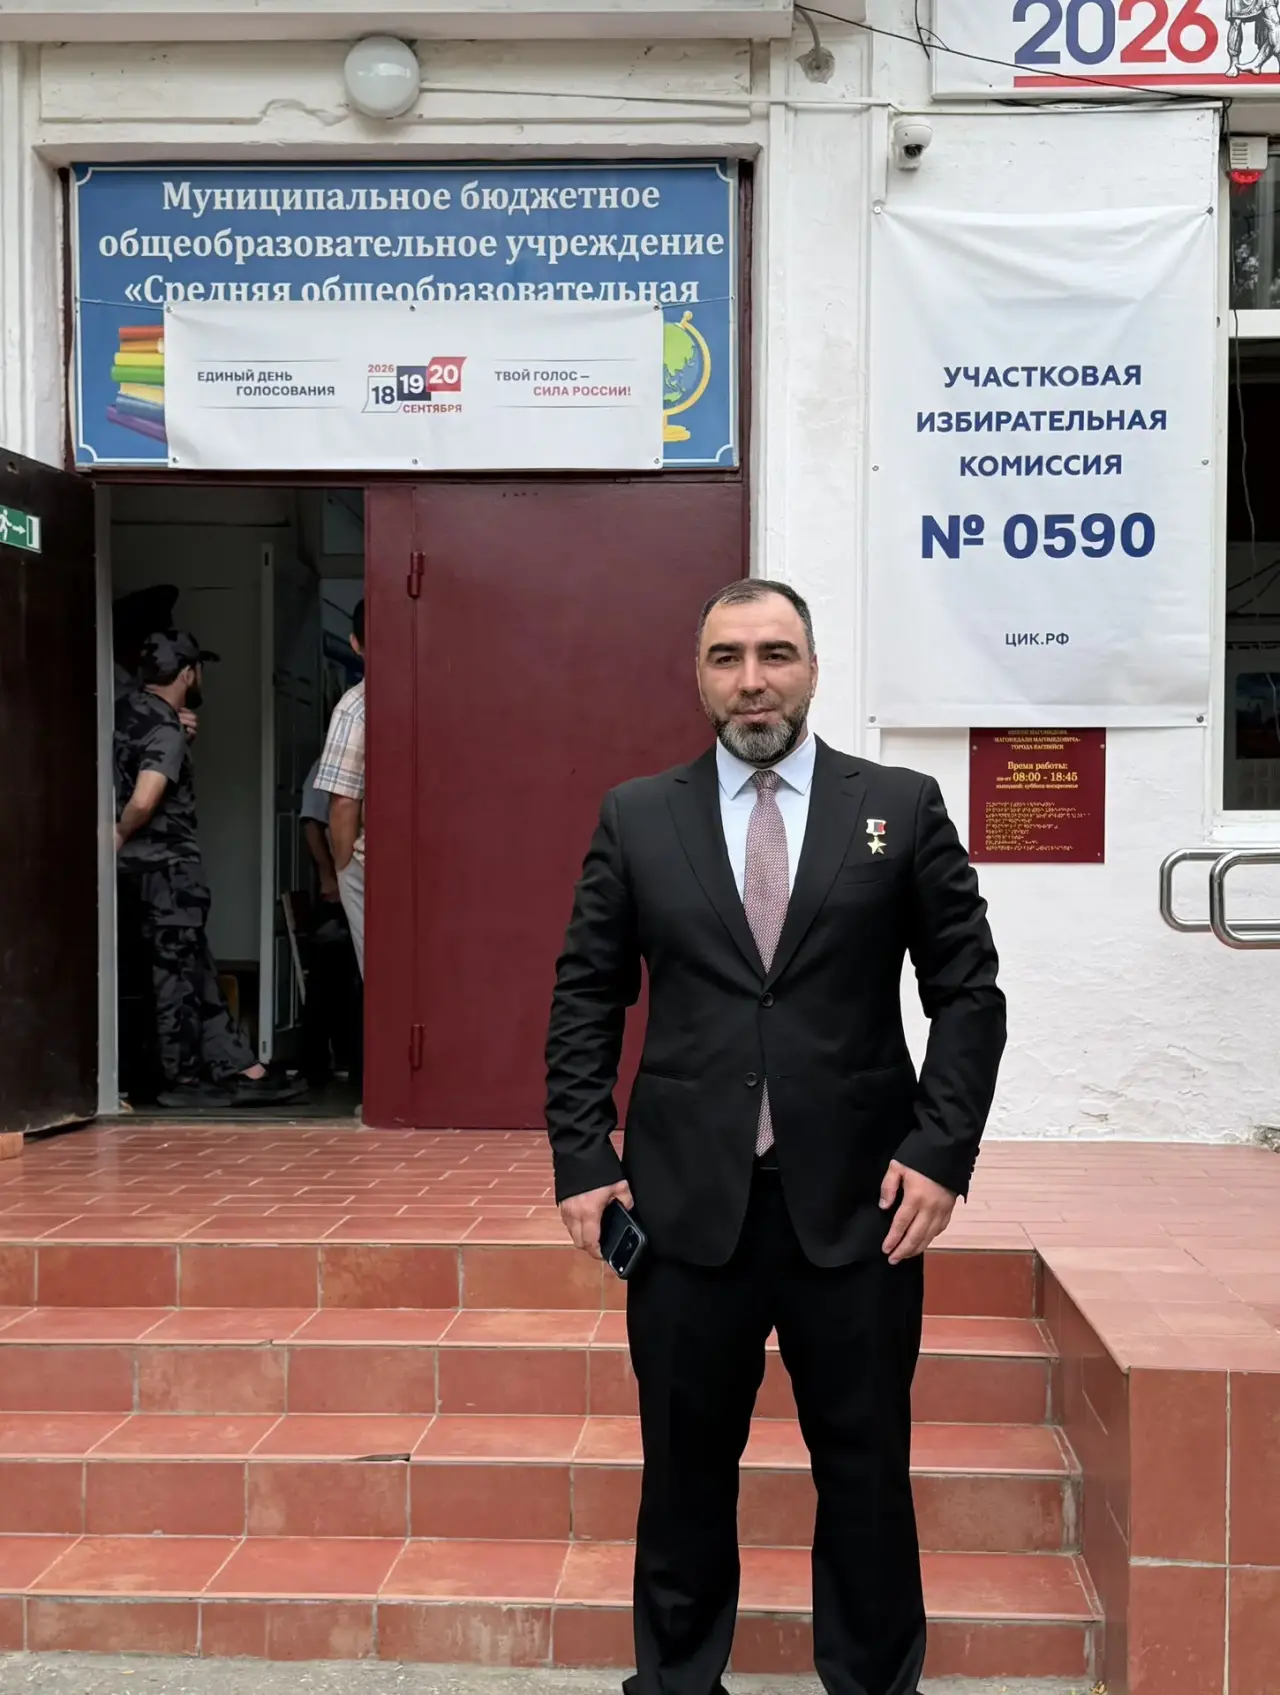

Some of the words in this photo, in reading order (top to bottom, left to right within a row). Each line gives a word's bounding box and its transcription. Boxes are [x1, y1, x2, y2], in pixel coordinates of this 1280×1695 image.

[1012, 0, 1219, 65] 2026
[162, 181, 451, 218] Муниципальное
[460, 180, 660, 216] бюджетное
[99, 227, 497, 265] общеобразовательное
[505, 232, 724, 264] учреждение
[124, 274, 292, 302] «Средняя
[197, 369, 255, 382] ЕДИНЫЙ
[257, 371, 293, 383] ДЕНЬ
[368, 364, 394, 373] 2026
[495, 369, 530, 381] ТВОЙ
[533, 371, 578, 381] ГОЛОС
[943, 365, 1142, 388] УЧАСТКОВАЯ
[236, 385, 335, 396] ГОЛОСОВАНИЯ
[371, 385, 395, 405] 18
[400, 374, 424, 394] 19
[429, 364, 459, 384] 20
[533, 386, 569, 396] СИЛА
[572, 386, 631, 396] РОССИИ!
[403, 404, 462, 413] СЕНТЯБРЯ
[917, 409, 1167, 433] ИЗБИРАТЕЛЬНАЯ
[959, 454, 1122, 477] КОМИССИЯ
[921, 514, 985, 559] №
[1003, 512, 1156, 559] 0590
[1005, 632, 1069, 647] ЦИК.РФ
[1007, 761, 1034, 771] Время
[1035, 761, 1068, 771] работы:
[1012, 771, 1041, 782] 08:00
[1050, 771, 1078, 782] 18:45
